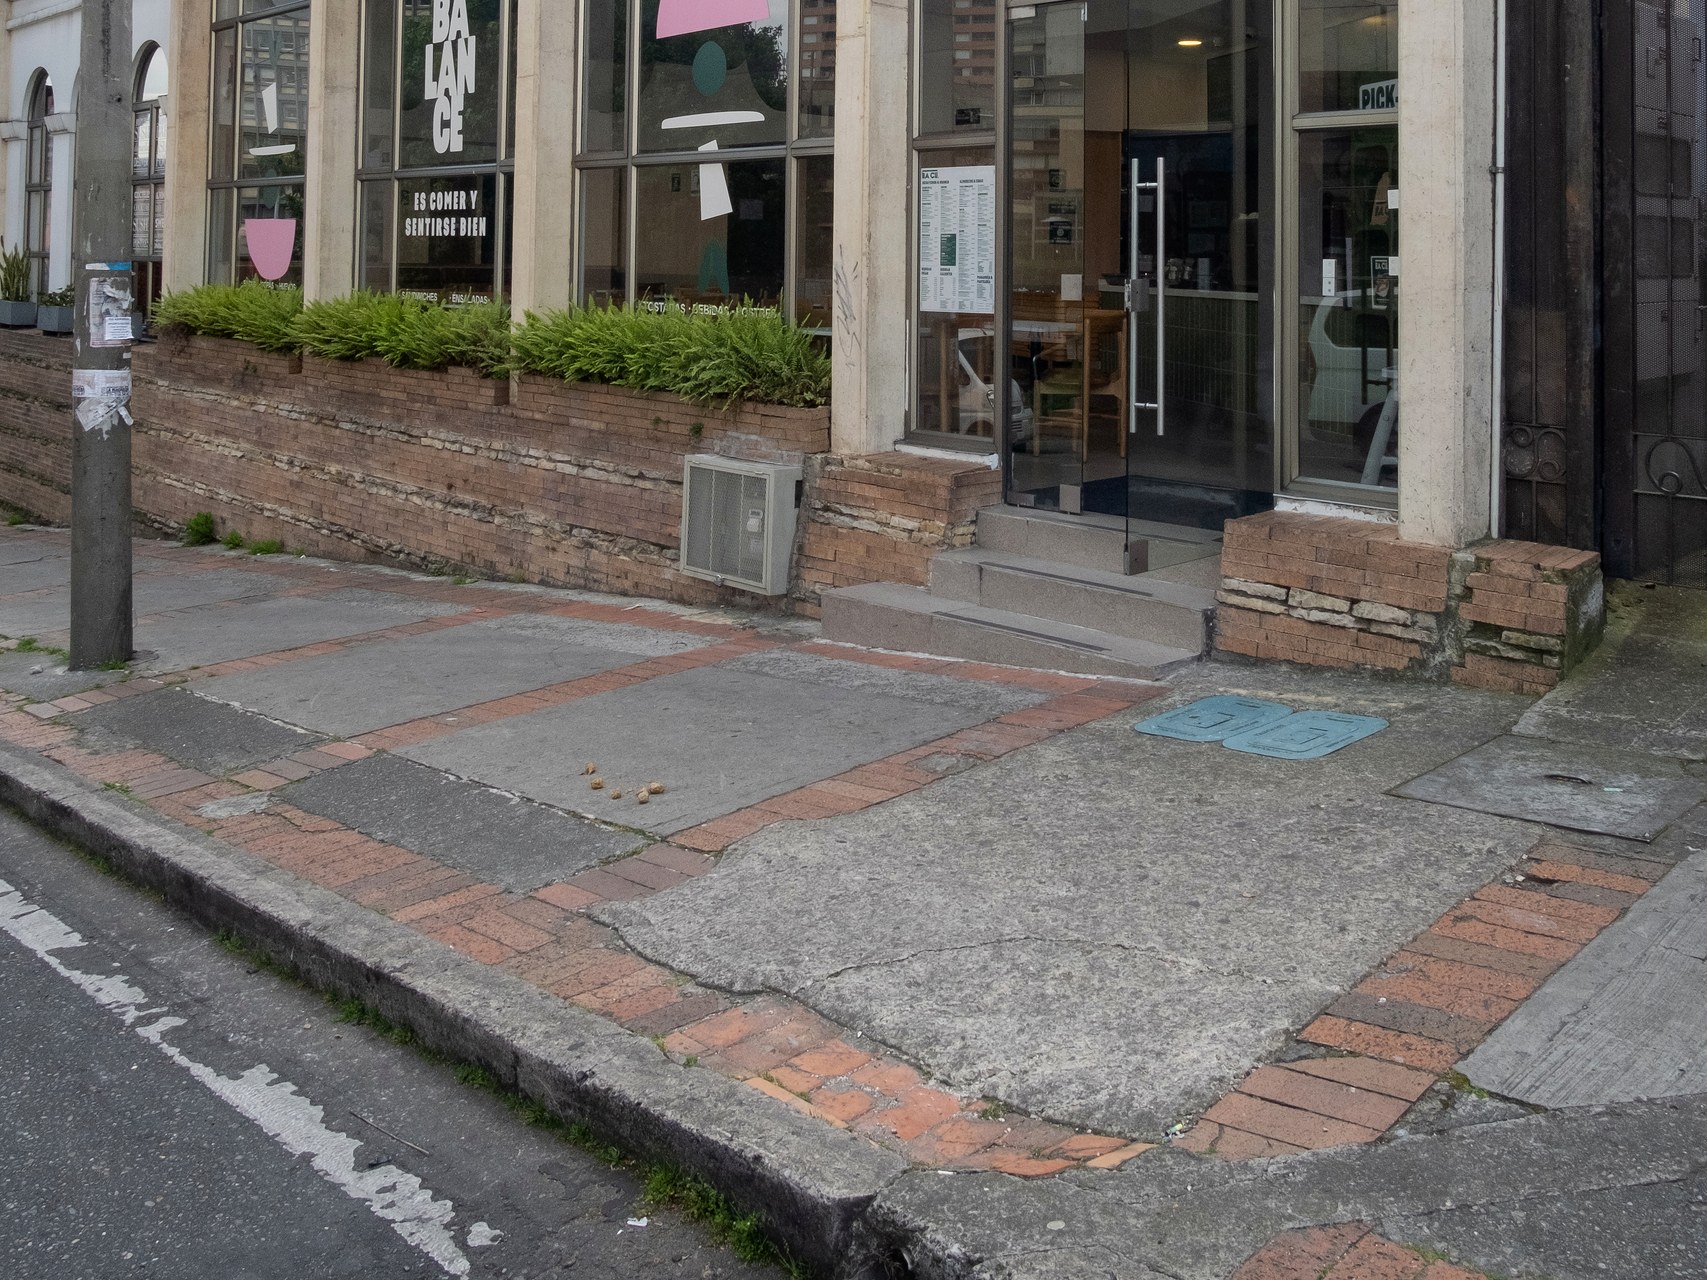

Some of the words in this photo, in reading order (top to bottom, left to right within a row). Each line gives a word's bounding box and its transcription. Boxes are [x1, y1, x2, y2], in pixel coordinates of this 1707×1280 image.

[414, 192, 427, 211] ES
[429, 190, 466, 211] COMER
[470, 190, 478, 210] Y
[405, 217, 456, 237] SENTIRSE
[459, 216, 487, 237] BIEN
